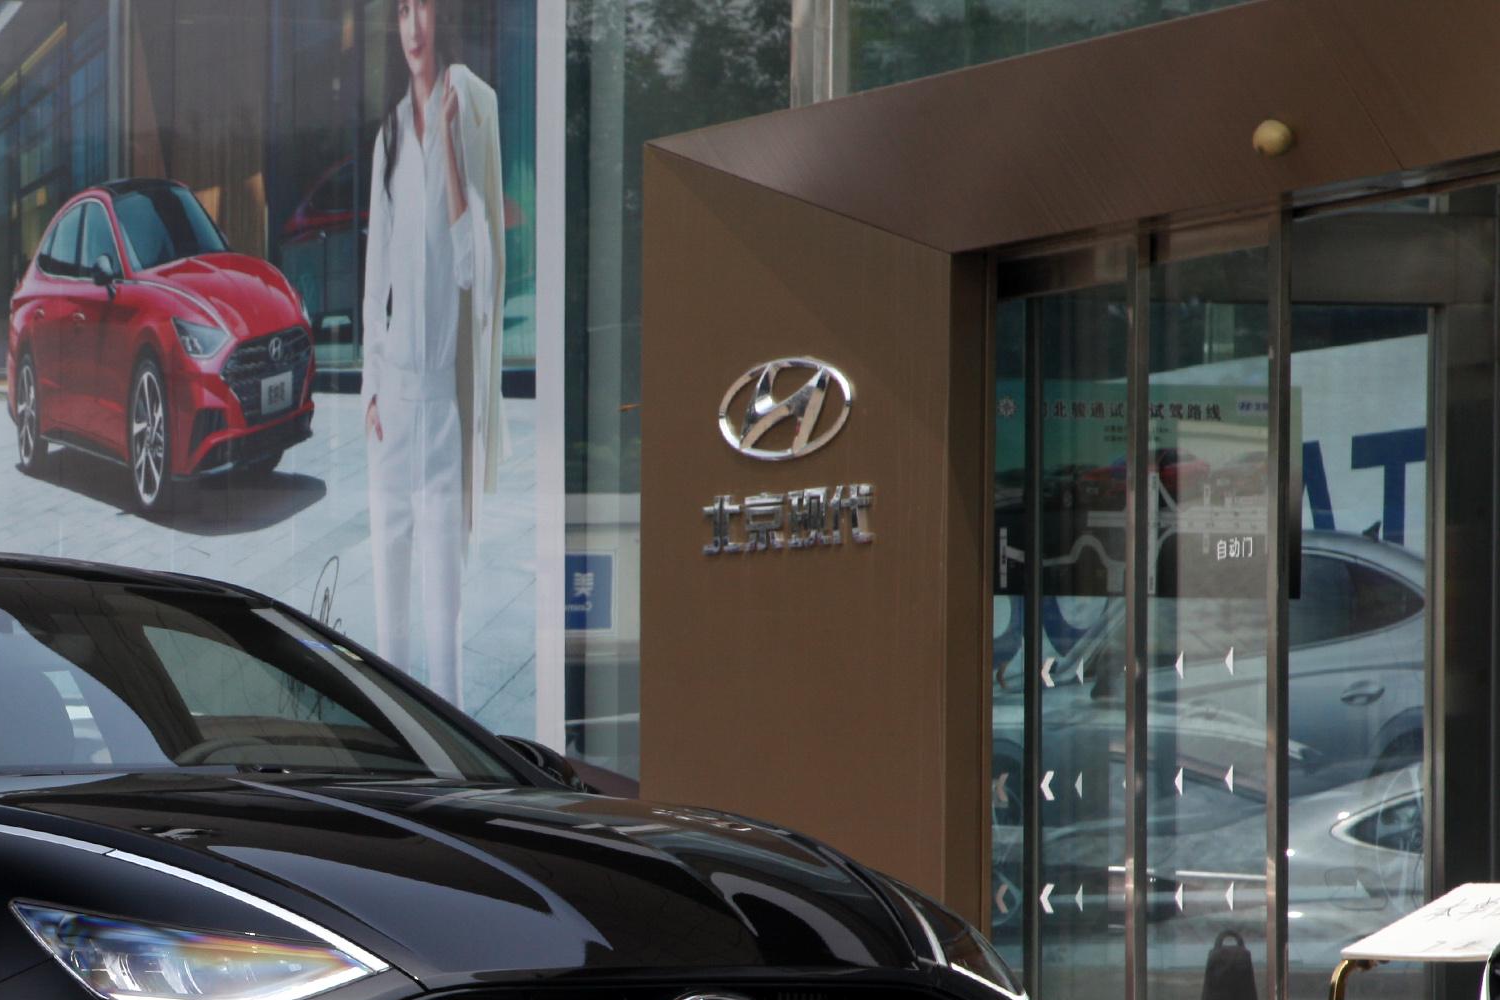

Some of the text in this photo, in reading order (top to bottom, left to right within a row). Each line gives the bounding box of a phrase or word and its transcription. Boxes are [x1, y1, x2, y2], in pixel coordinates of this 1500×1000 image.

[703, 483, 874, 555] 北京现代
[1216, 536, 1253, 560] 自动门
